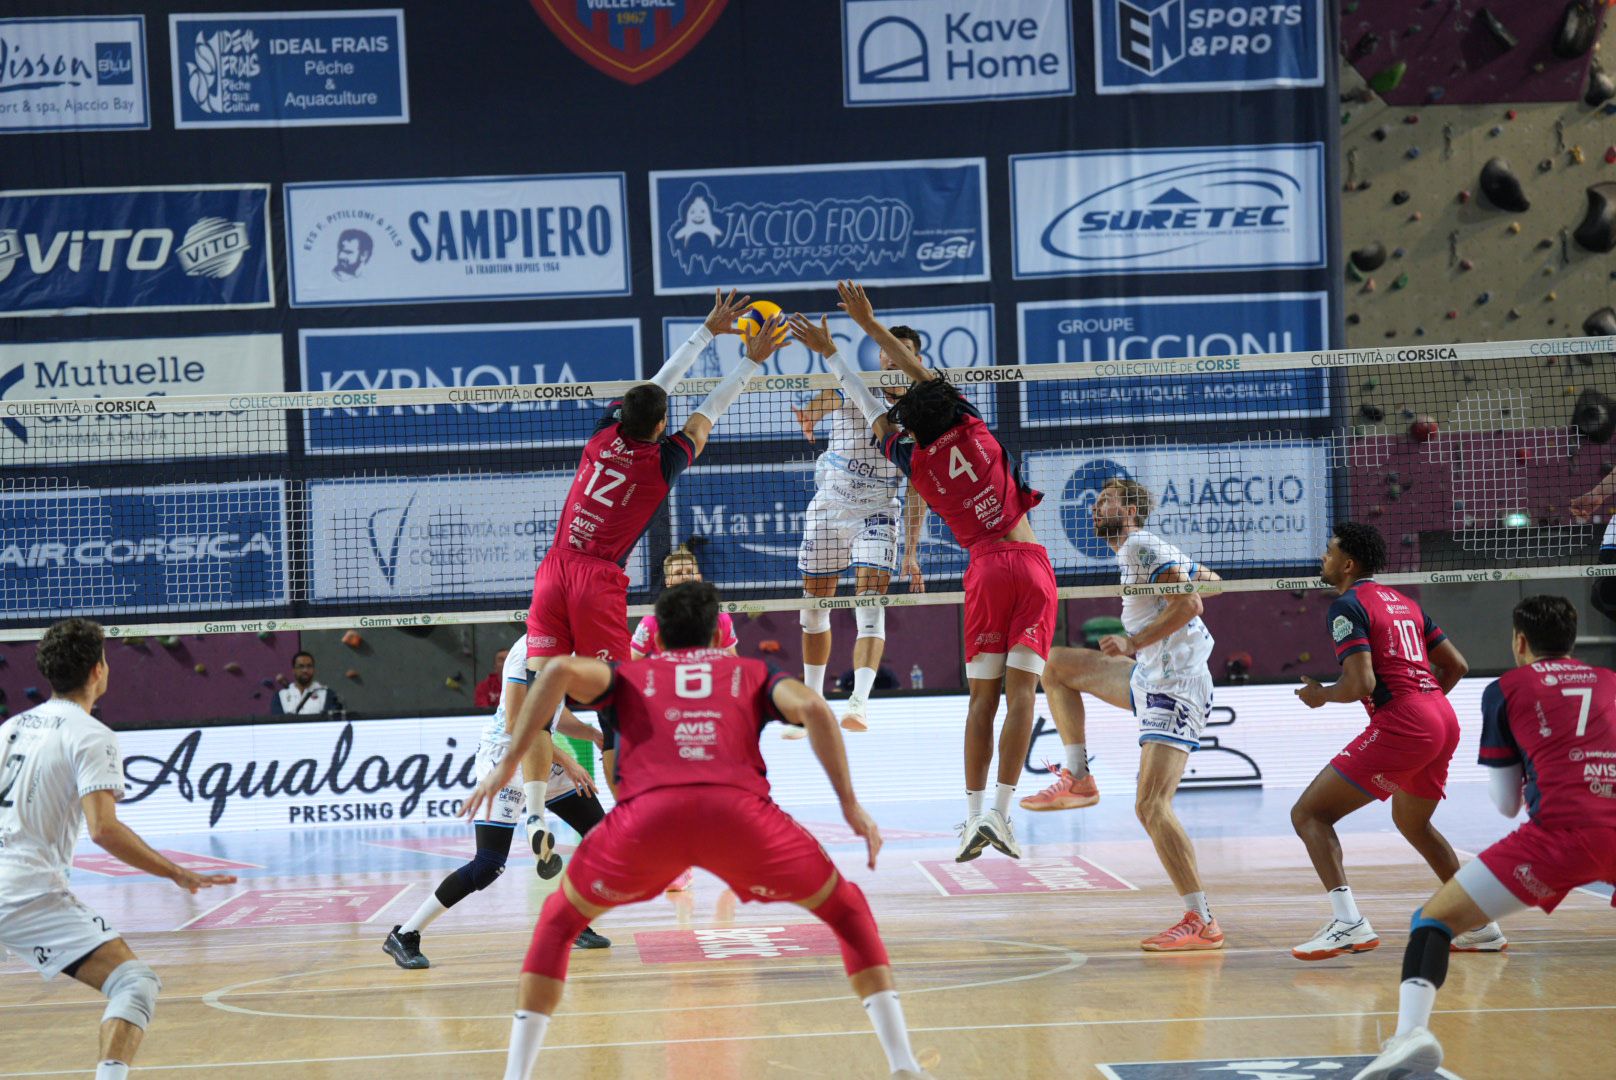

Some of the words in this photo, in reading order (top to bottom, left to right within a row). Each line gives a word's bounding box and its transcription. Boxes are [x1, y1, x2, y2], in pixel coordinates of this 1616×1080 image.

[617, 12, 647, 24] 1967
[1187, 5, 1302, 29] SPORTS
[945, 12, 1038, 44] Kave
[269, 38, 327, 55] IDEAL
[331, 36, 389, 53] FRAIS
[1188, 34, 1271, 56] &PRO
[305, 60, 354, 76] Pêche
[946, 48, 1060, 81] Home
[325, 78, 336, 90] &
[22, 100, 31, 113] &
[65, 99, 108, 114] Ajaccio
[114, 97, 134, 113] Bay
[284, 91, 378, 109] Aquaculture
[825, 205, 908, 244] FROID
[1078, 206, 1289, 232] SURETEC
[385, 225, 402, 248] FILS
[408, 204, 612, 263] SAMPIERO
[772, 244, 868, 260] DIFFUSION
[916, 240, 976, 260] Gasel
[476, 263, 512, 275] TRADITION
[515, 262, 540, 273] DEPUIS
[1057, 316, 1135, 335] GROUPE
[1530, 337, 1614, 355] COLLECTIVITÉ
[1311, 348, 1384, 366] CULLETTIVITÀ
[1386, 353, 1396, 363] DI
[1397, 348, 1458, 362] CORSICA
[35, 355, 205, 388] Mutuelle
[954, 374, 963, 383] DI
[965, 369, 1024, 382] CORSICA
[1095, 360, 1177, 376] COLLECTIVITÉ
[1180, 362, 1192, 373] DE
[1195, 358, 1241, 372] CORSE
[749, 381, 762, 391] DE
[765, 378, 809, 390] CORSE
[1060, 384, 1188, 405] BUREAUTIQUE
[1204, 382, 1293, 399] MOBILIER
[229, 393, 313, 410] COLLECTIVITÉ
[316, 397, 329, 407] DE
[332, 393, 377, 406] CORSE
[449, 386, 520, 402] CULLETTIVITÀ
[523, 390, 532, 399] DI
[534, 386, 594, 399] CORSICA
[7, 400, 81, 416] CULLETTIVITÀ
[84, 404, 93, 414] DI
[95, 400, 156, 414] CORSICA
[948, 445, 979, 483] 4
[584, 460, 626, 507] 12
[1160, 475, 1305, 507] AJACCIO
[974, 494, 998, 515] AVIS
[572, 516, 597, 533] AVIS
[0, 543, 67, 568] AIR
[73, 532, 272, 566] CORSICA
[1276, 579, 1307, 590] Gamm
[1310, 579, 1329, 588] ver
[1430, 573, 1462, 583] Gamm
[1467, 571, 1488, 582] vert
[1123, 585, 1155, 596] Gamm
[1159, 584, 1181, 594] vert
[819, 598, 850, 609] Gamm
[854, 597, 876, 607] vert
[360, 616, 392, 627] Gamm
[396, 615, 418, 625] vert
[514, 611, 528, 621] Ga
[204, 622, 236, 633] Gamm
[240, 621, 263, 632] vert
[1393, 620, 1423, 662] 10
[675, 663, 712, 699] 6
[1561, 688, 1592, 737] 7
[675, 720, 715, 734] AVIS
[0, 754, 25, 807] 2
[289, 803, 394, 823] PRESSING
[92, 916, 112, 932] 2
